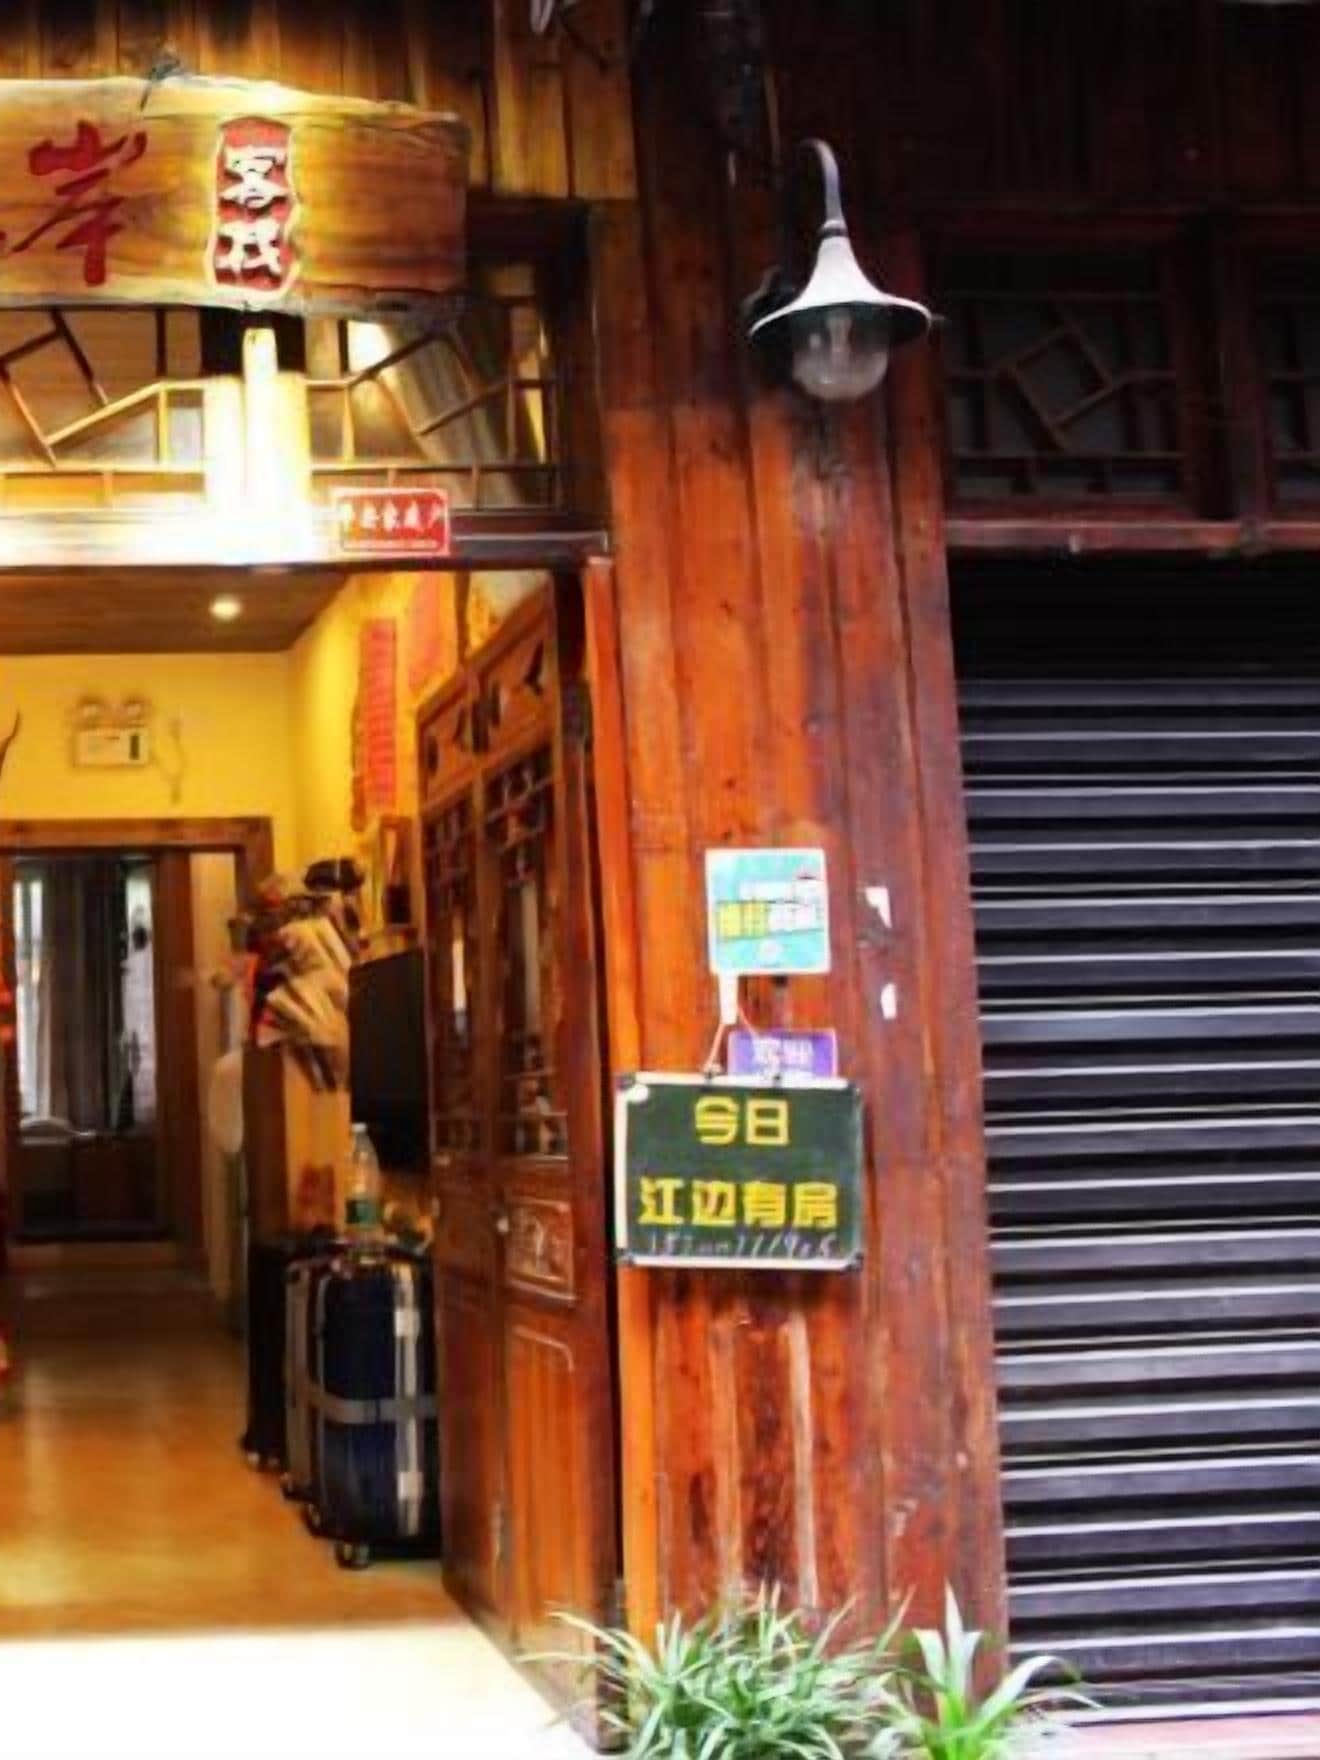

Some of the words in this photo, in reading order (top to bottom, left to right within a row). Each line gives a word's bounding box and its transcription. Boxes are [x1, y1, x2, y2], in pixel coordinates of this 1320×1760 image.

[694, 1096, 789, 1146] 今日
[638, 1176, 838, 1228] 江边有房
